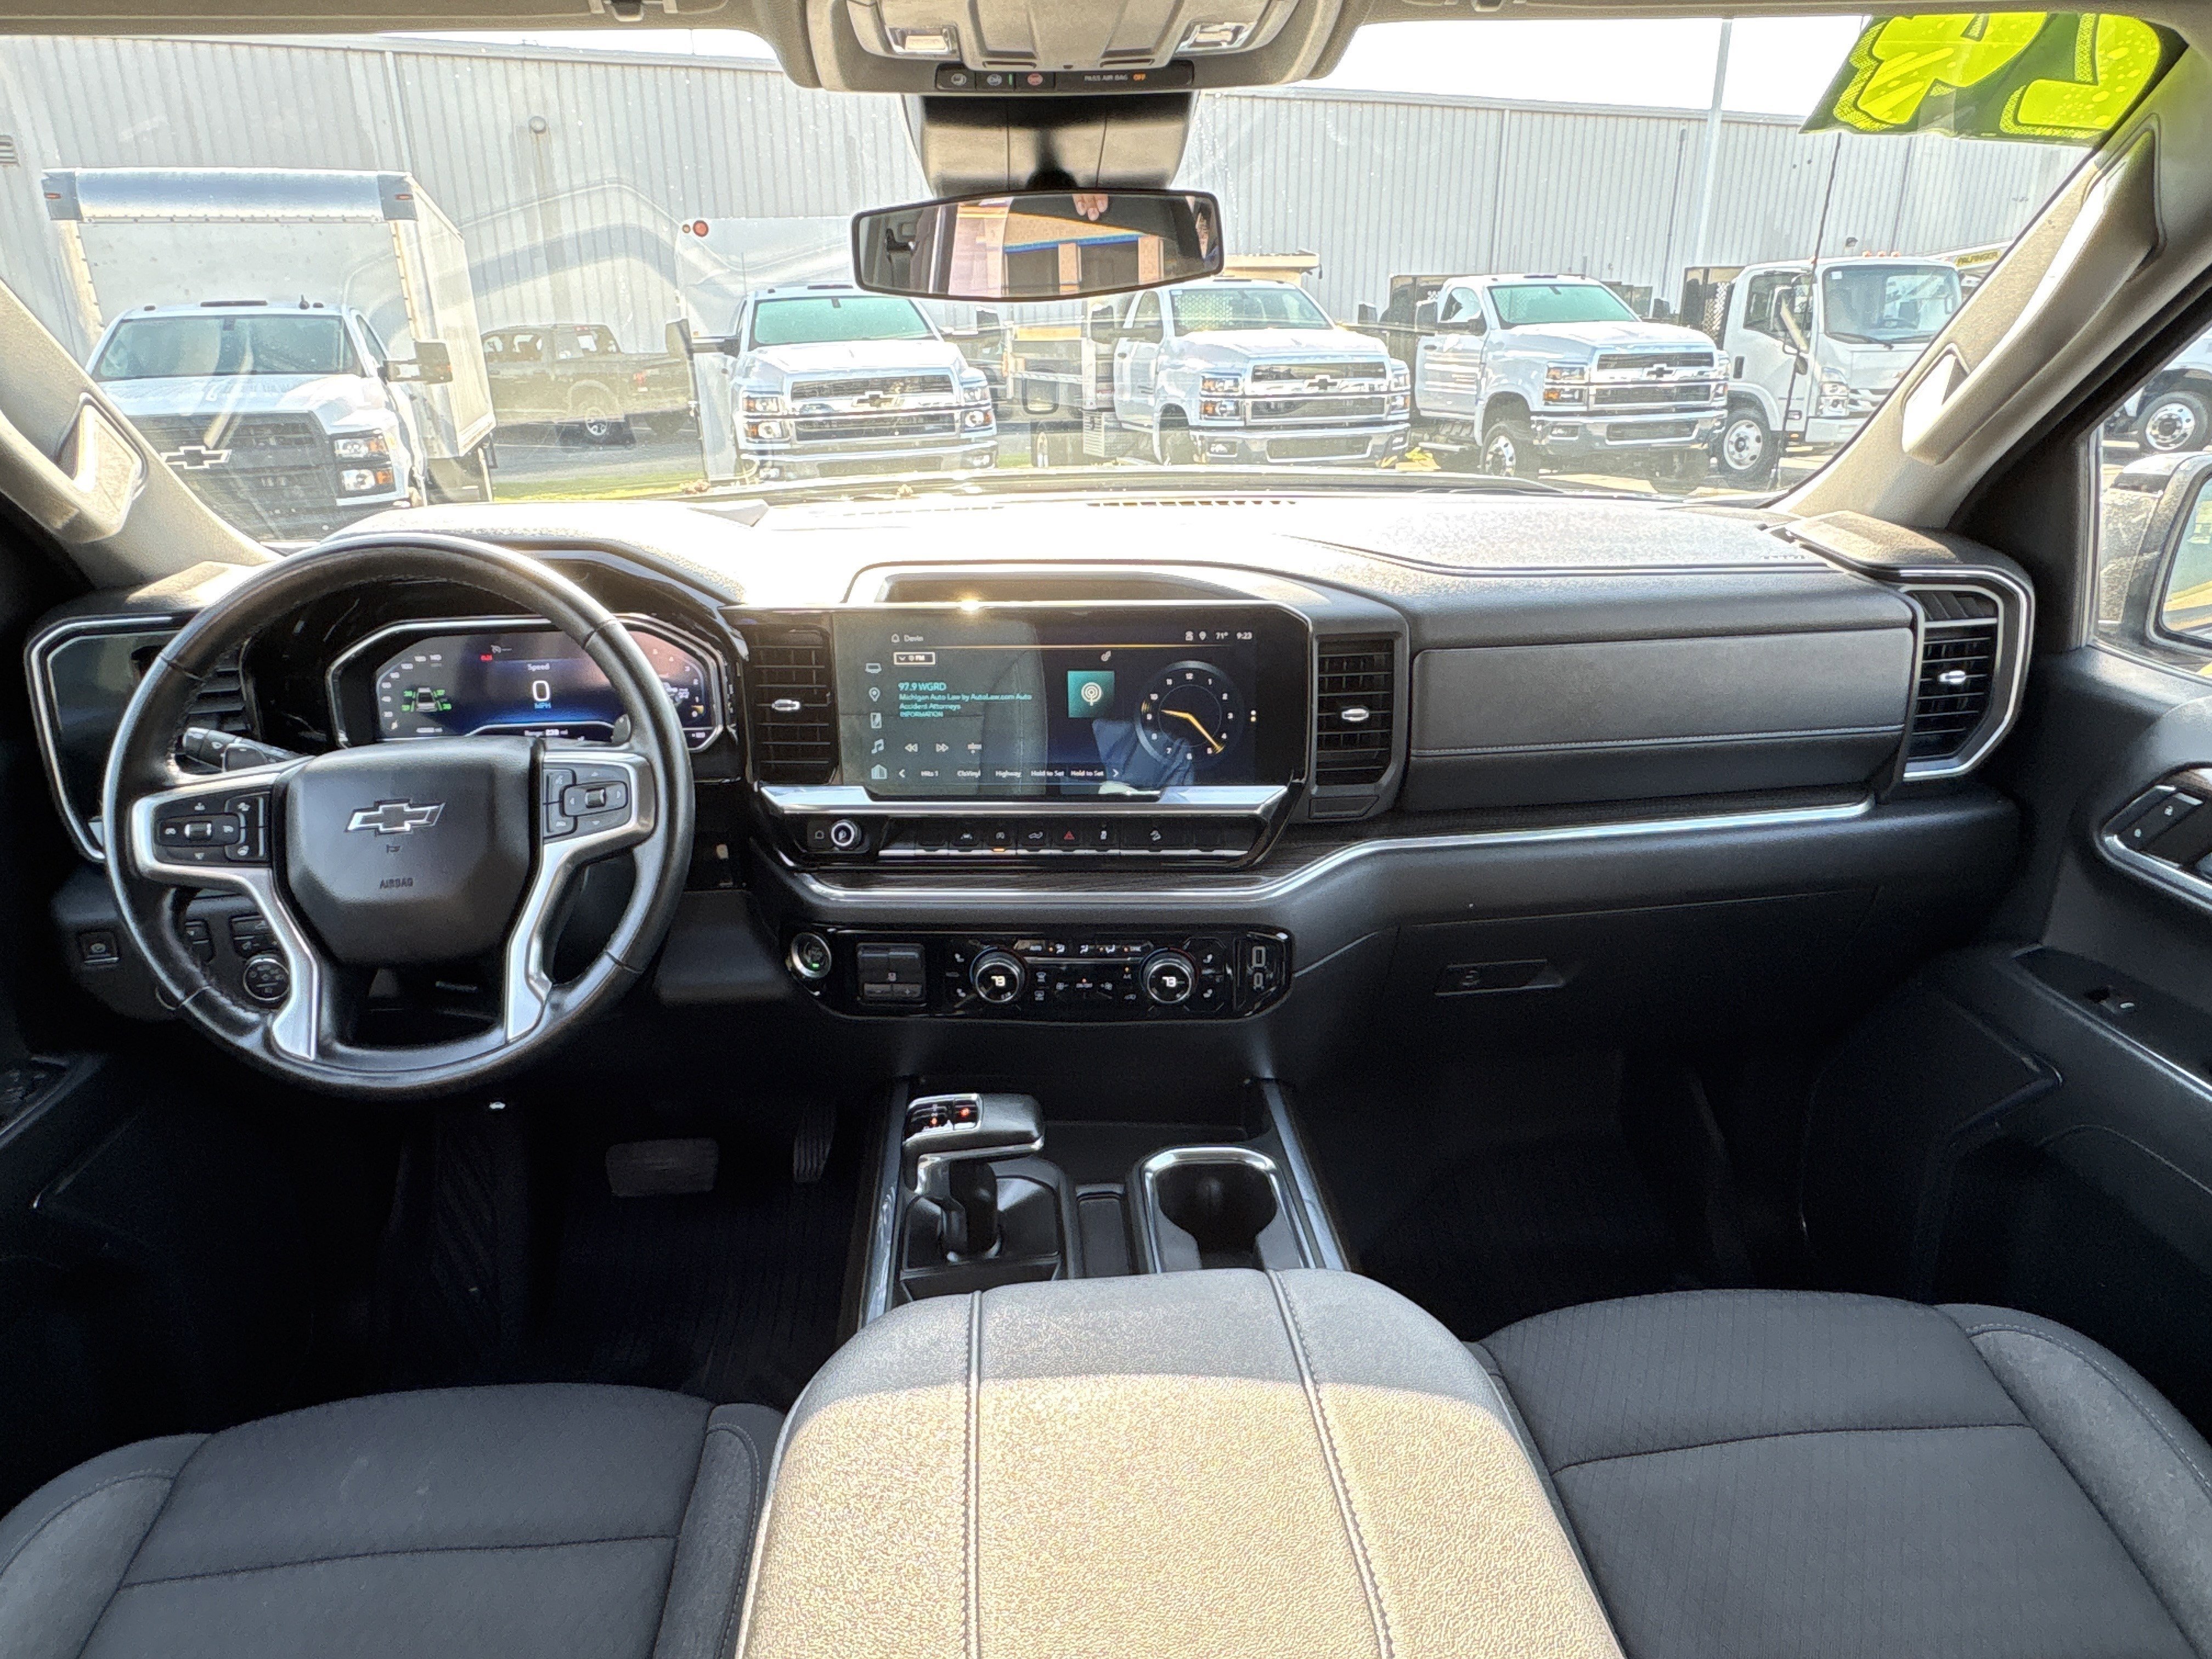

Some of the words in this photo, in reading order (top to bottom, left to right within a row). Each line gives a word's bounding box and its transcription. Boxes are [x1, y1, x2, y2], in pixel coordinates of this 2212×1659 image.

[527, 663, 550, 671] Speed
[532, 680, 550, 702] 0
[898, 682, 917, 691] 97.9
[918, 682, 946, 691] WGRD
[899, 693, 929, 702] Michigan
[996, 770, 1021, 778] Highway
[380, 878, 414, 889] AIRBAG
